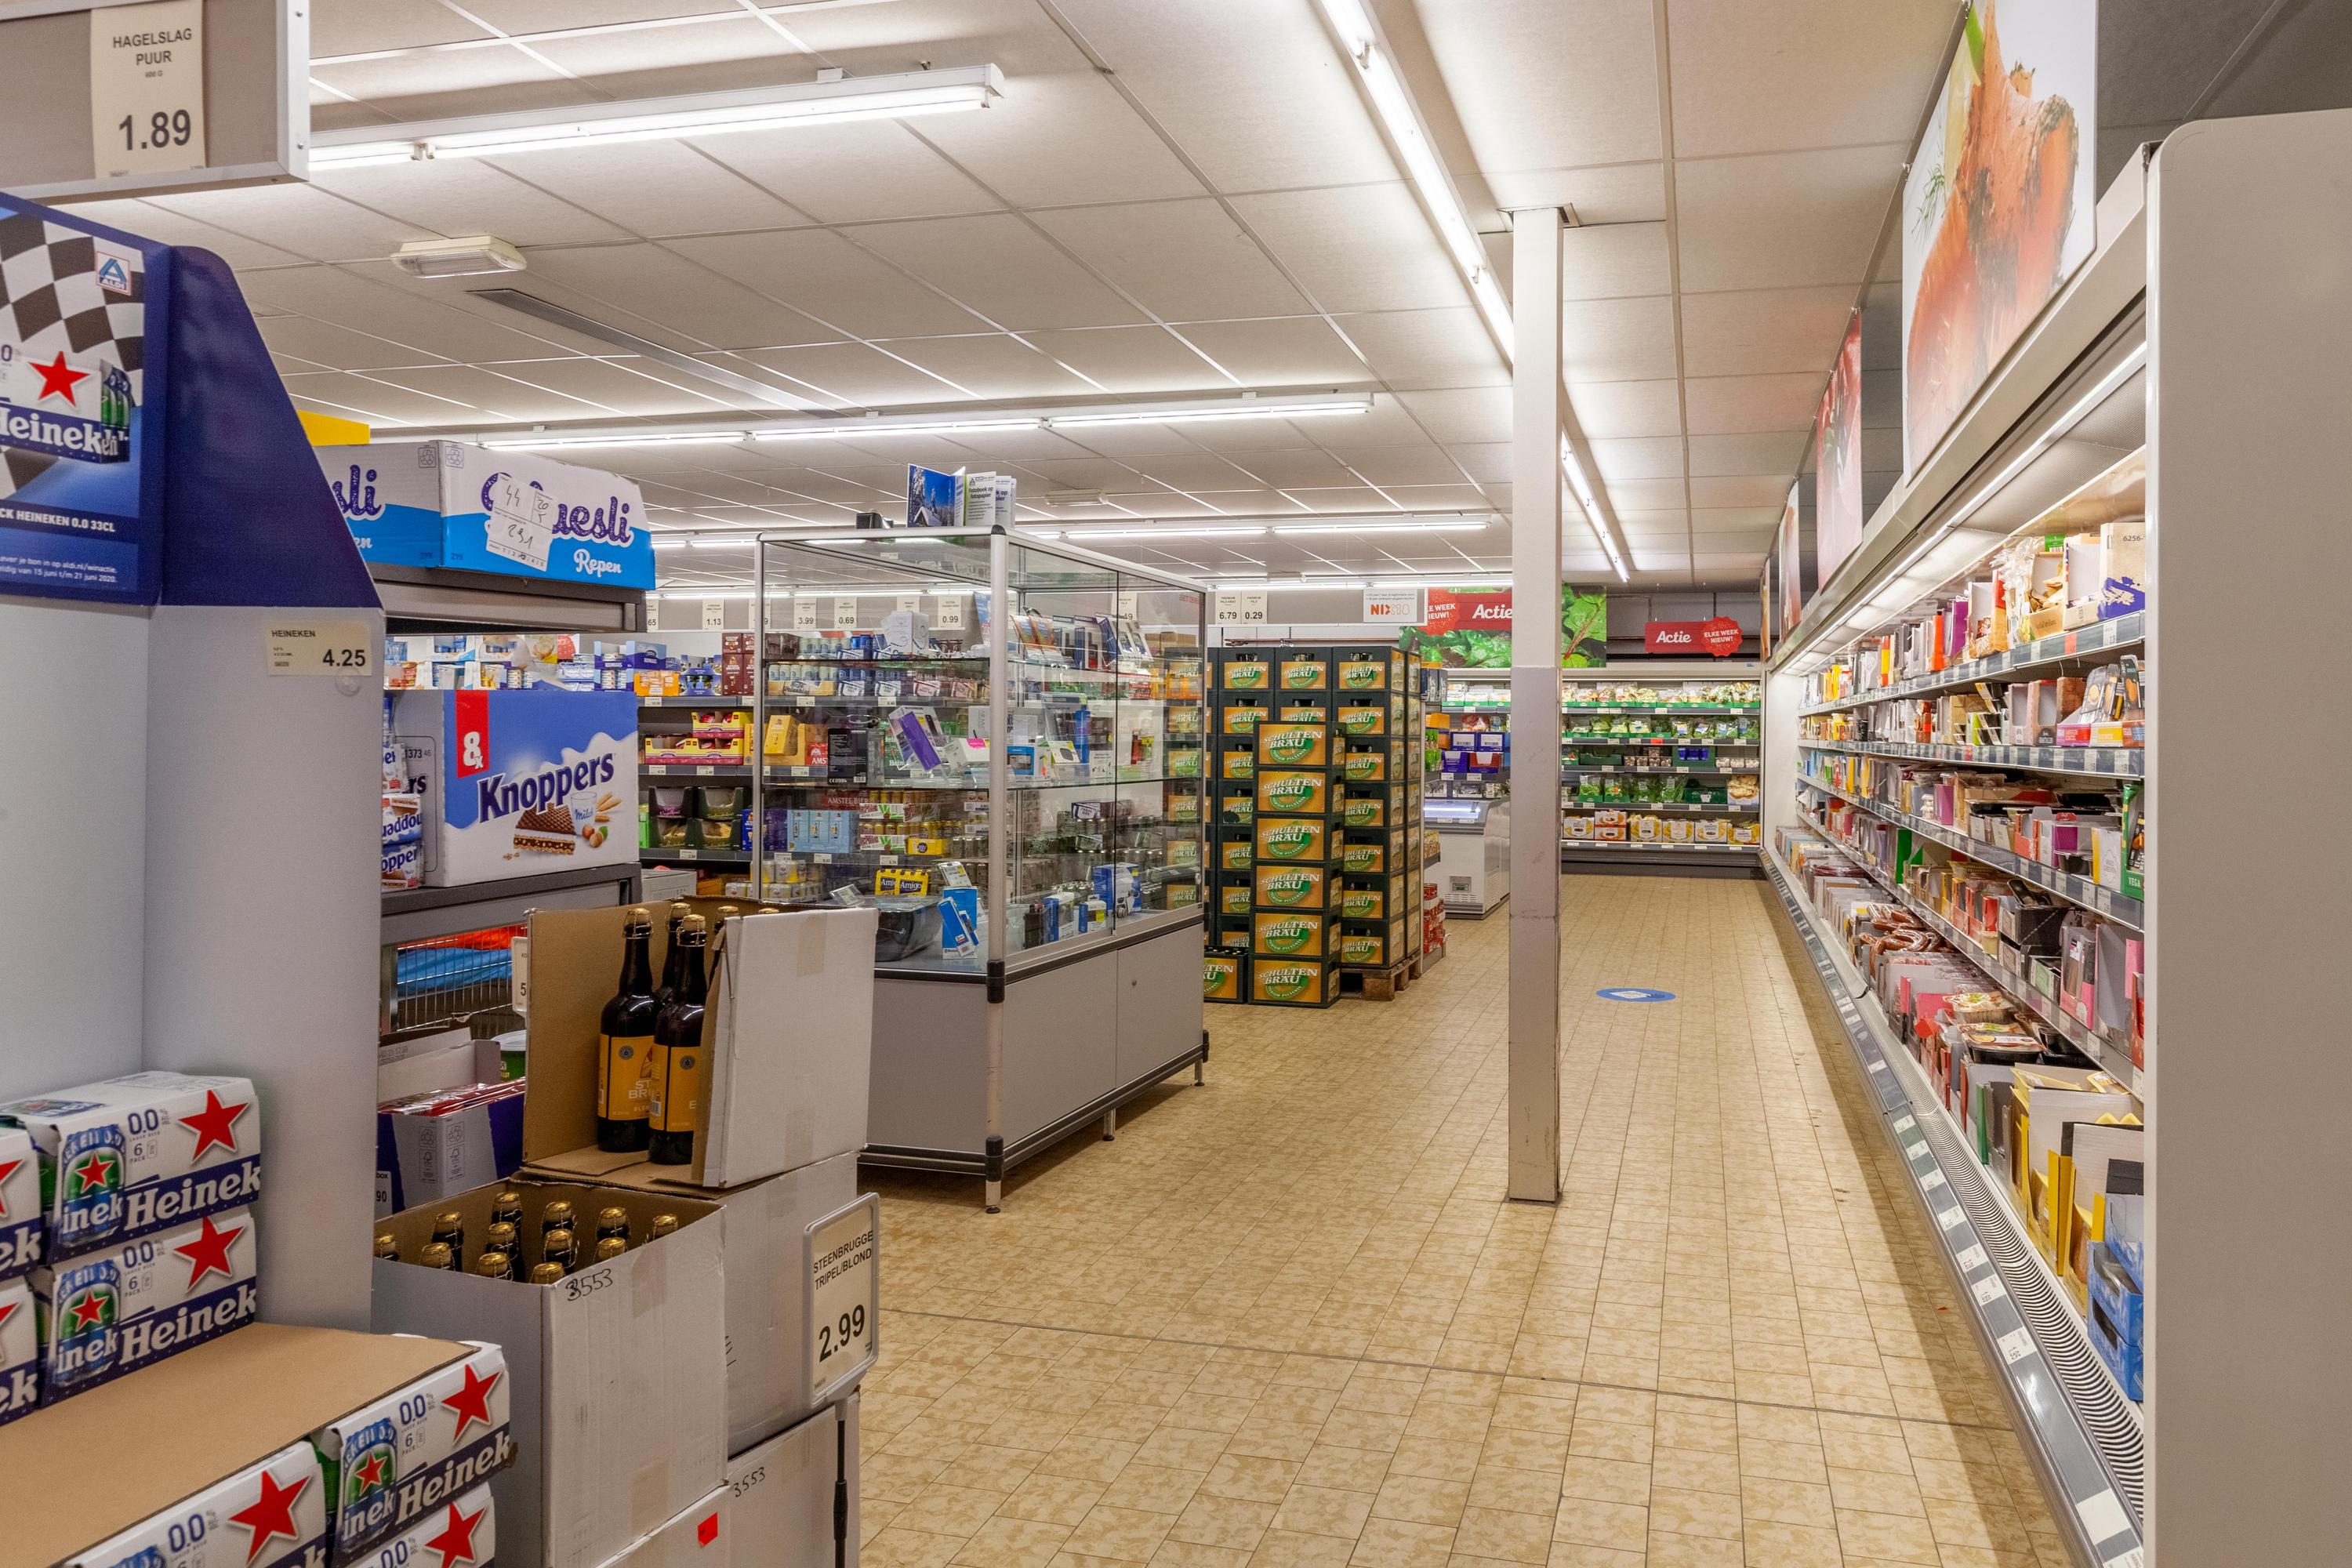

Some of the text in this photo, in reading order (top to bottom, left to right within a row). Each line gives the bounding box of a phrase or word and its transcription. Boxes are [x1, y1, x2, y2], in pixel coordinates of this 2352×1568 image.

[113, 28, 192, 49] HAGELSLAG
[136, 50, 172, 66] PUUR
[119, 109, 191, 151] 1.89
[100, 278, 127, 291] ALDI
[16, 510, 70, 526] HEINEKEN
[71, 517, 89, 528] 0.0
[90, 520, 116, 532] 33CL
[573, 548, 622, 578] Repen
[1434, 603, 1456, 612] WEEK
[798, 616, 814, 625] 3.99
[1428, 611, 1450, 620] IEUW!
[1656, 631, 1692, 643] Actie
[322, 649, 366, 666] 4.25
[1263, 730, 1323, 743] SCHULTEN
[480, 753, 615, 822] Knoppers
[1262, 778, 1323, 790] SCHULTEN
[1261, 826, 1321, 837] SCHULTEN
[1261, 873, 1320, 884] SCHULTEN
[2128, 877, 2141, 887] VEGA
[901, 881, 922, 891] Amigo
[1259, 920, 1319, 932] SCHULTEN
[1258, 968, 1318, 979] SCHULTEN
[128, 1109, 159, 1135] 0.0
[134, 1143, 143, 1156] 6
[123, 1240, 154, 1269] 0.0
[813, 1230, 873, 1274] STEENBRUGGE
[815, 1247, 873, 1290] TRIPEL/BLOND
[129, 1276, 138, 1290] 6
[818, 1304, 866, 1363] 2.99
[399, 1394, 426, 1426] 0.0
[405, 1433, 413, 1447] 6
[733, 1466, 767, 1498] 3553
[168, 1513, 206, 1554] 0.0
